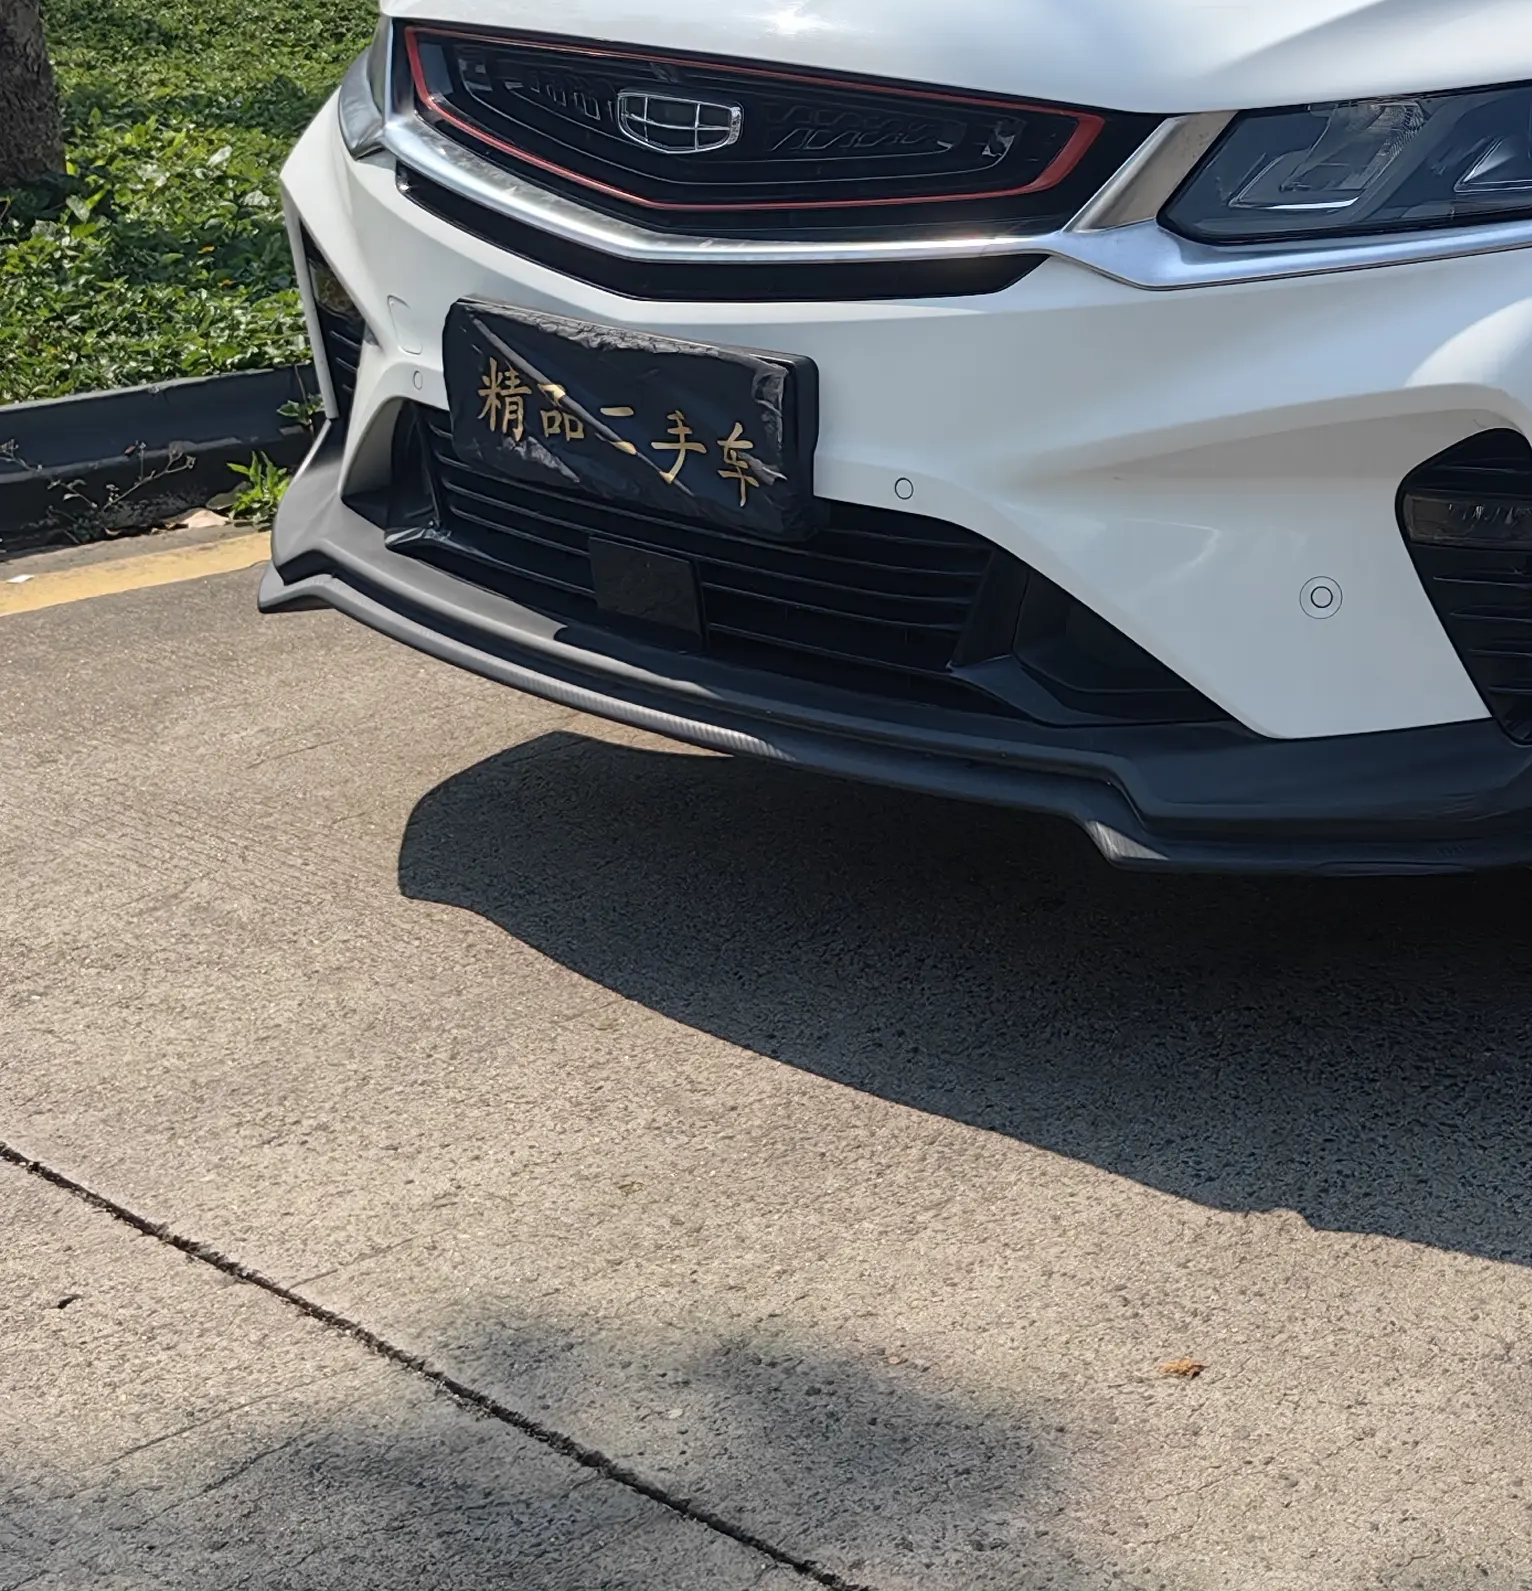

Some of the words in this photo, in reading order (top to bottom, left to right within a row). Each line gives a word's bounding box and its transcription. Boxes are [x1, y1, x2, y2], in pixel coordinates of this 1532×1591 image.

[477, 357, 760, 507] 精品二手车
